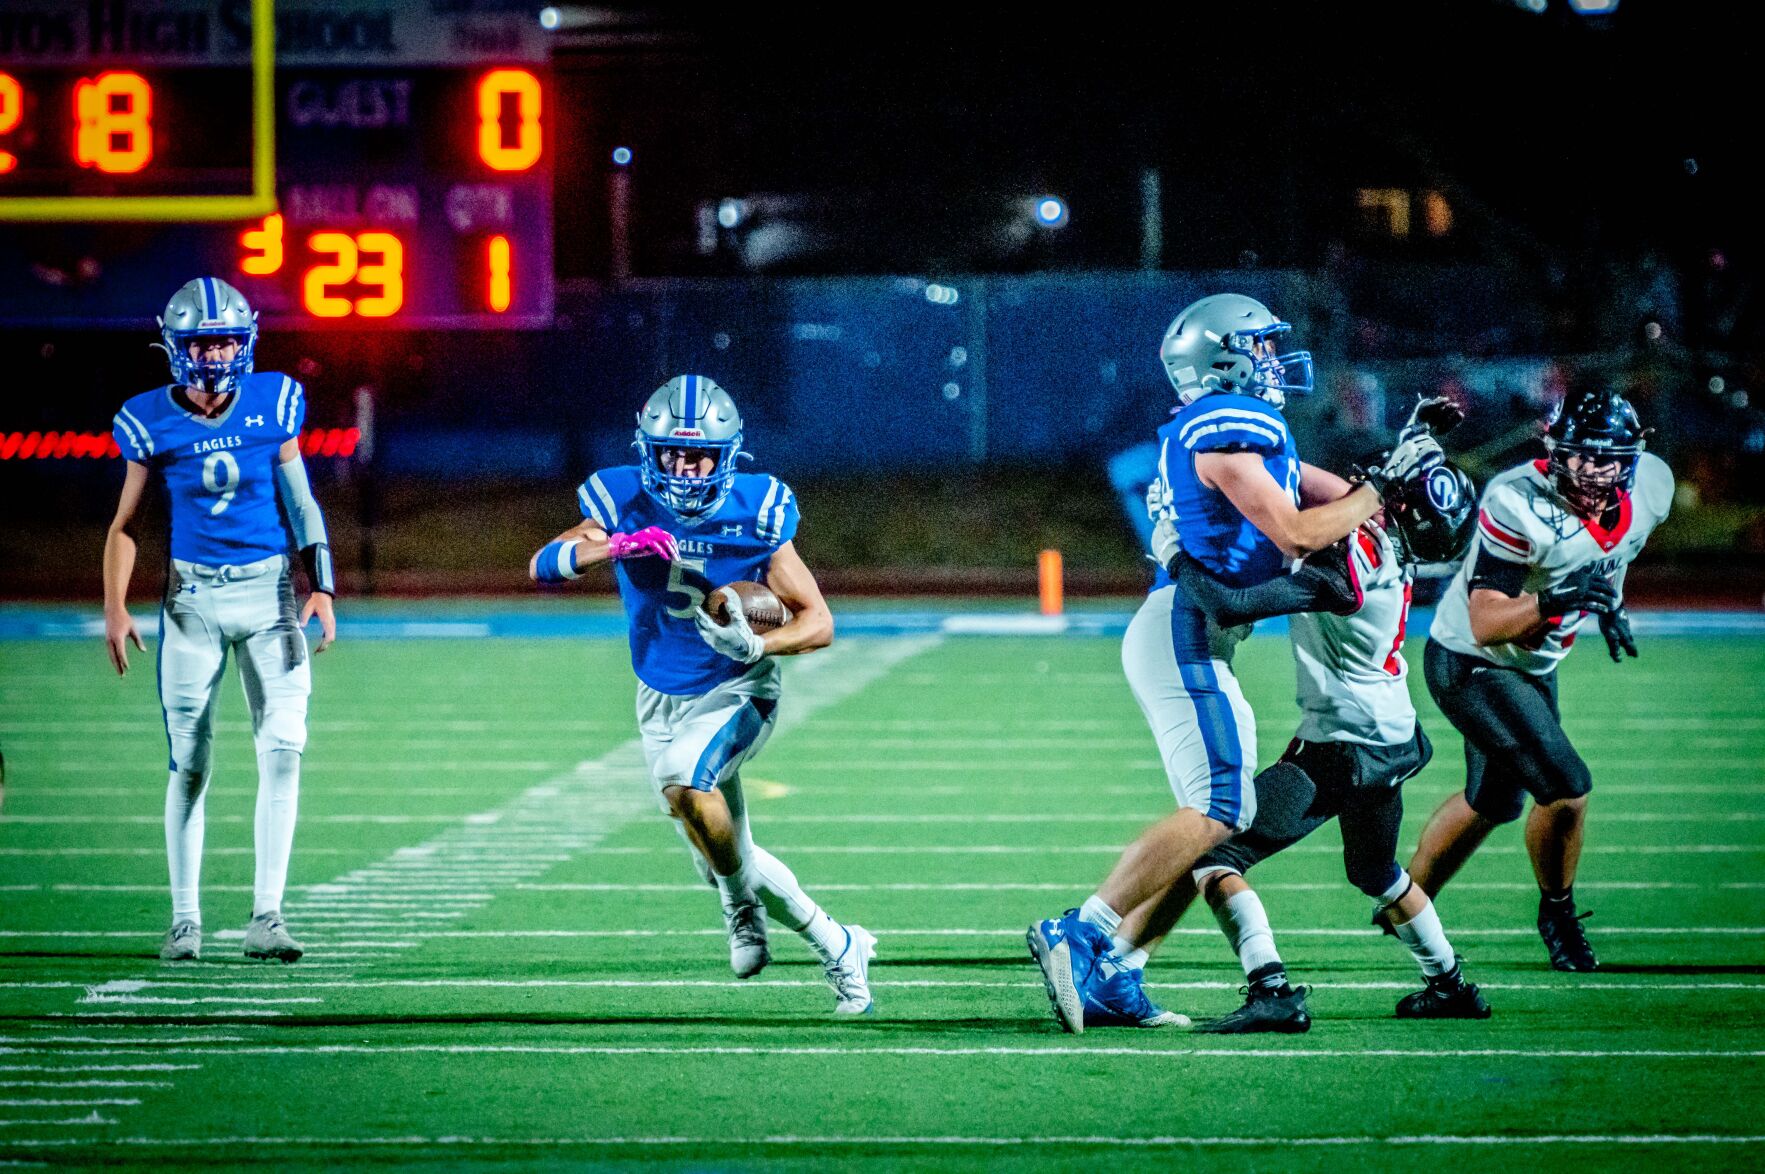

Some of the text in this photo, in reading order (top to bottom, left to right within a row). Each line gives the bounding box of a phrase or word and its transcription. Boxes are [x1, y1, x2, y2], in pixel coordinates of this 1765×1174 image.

[479, 70, 542, 170] 0
[304, 232, 403, 317] 23
[488, 236, 510, 312] 1
[194, 436, 242, 453] EAGLES
[203, 450, 240, 515] 9
[665, 556, 707, 620] 5
